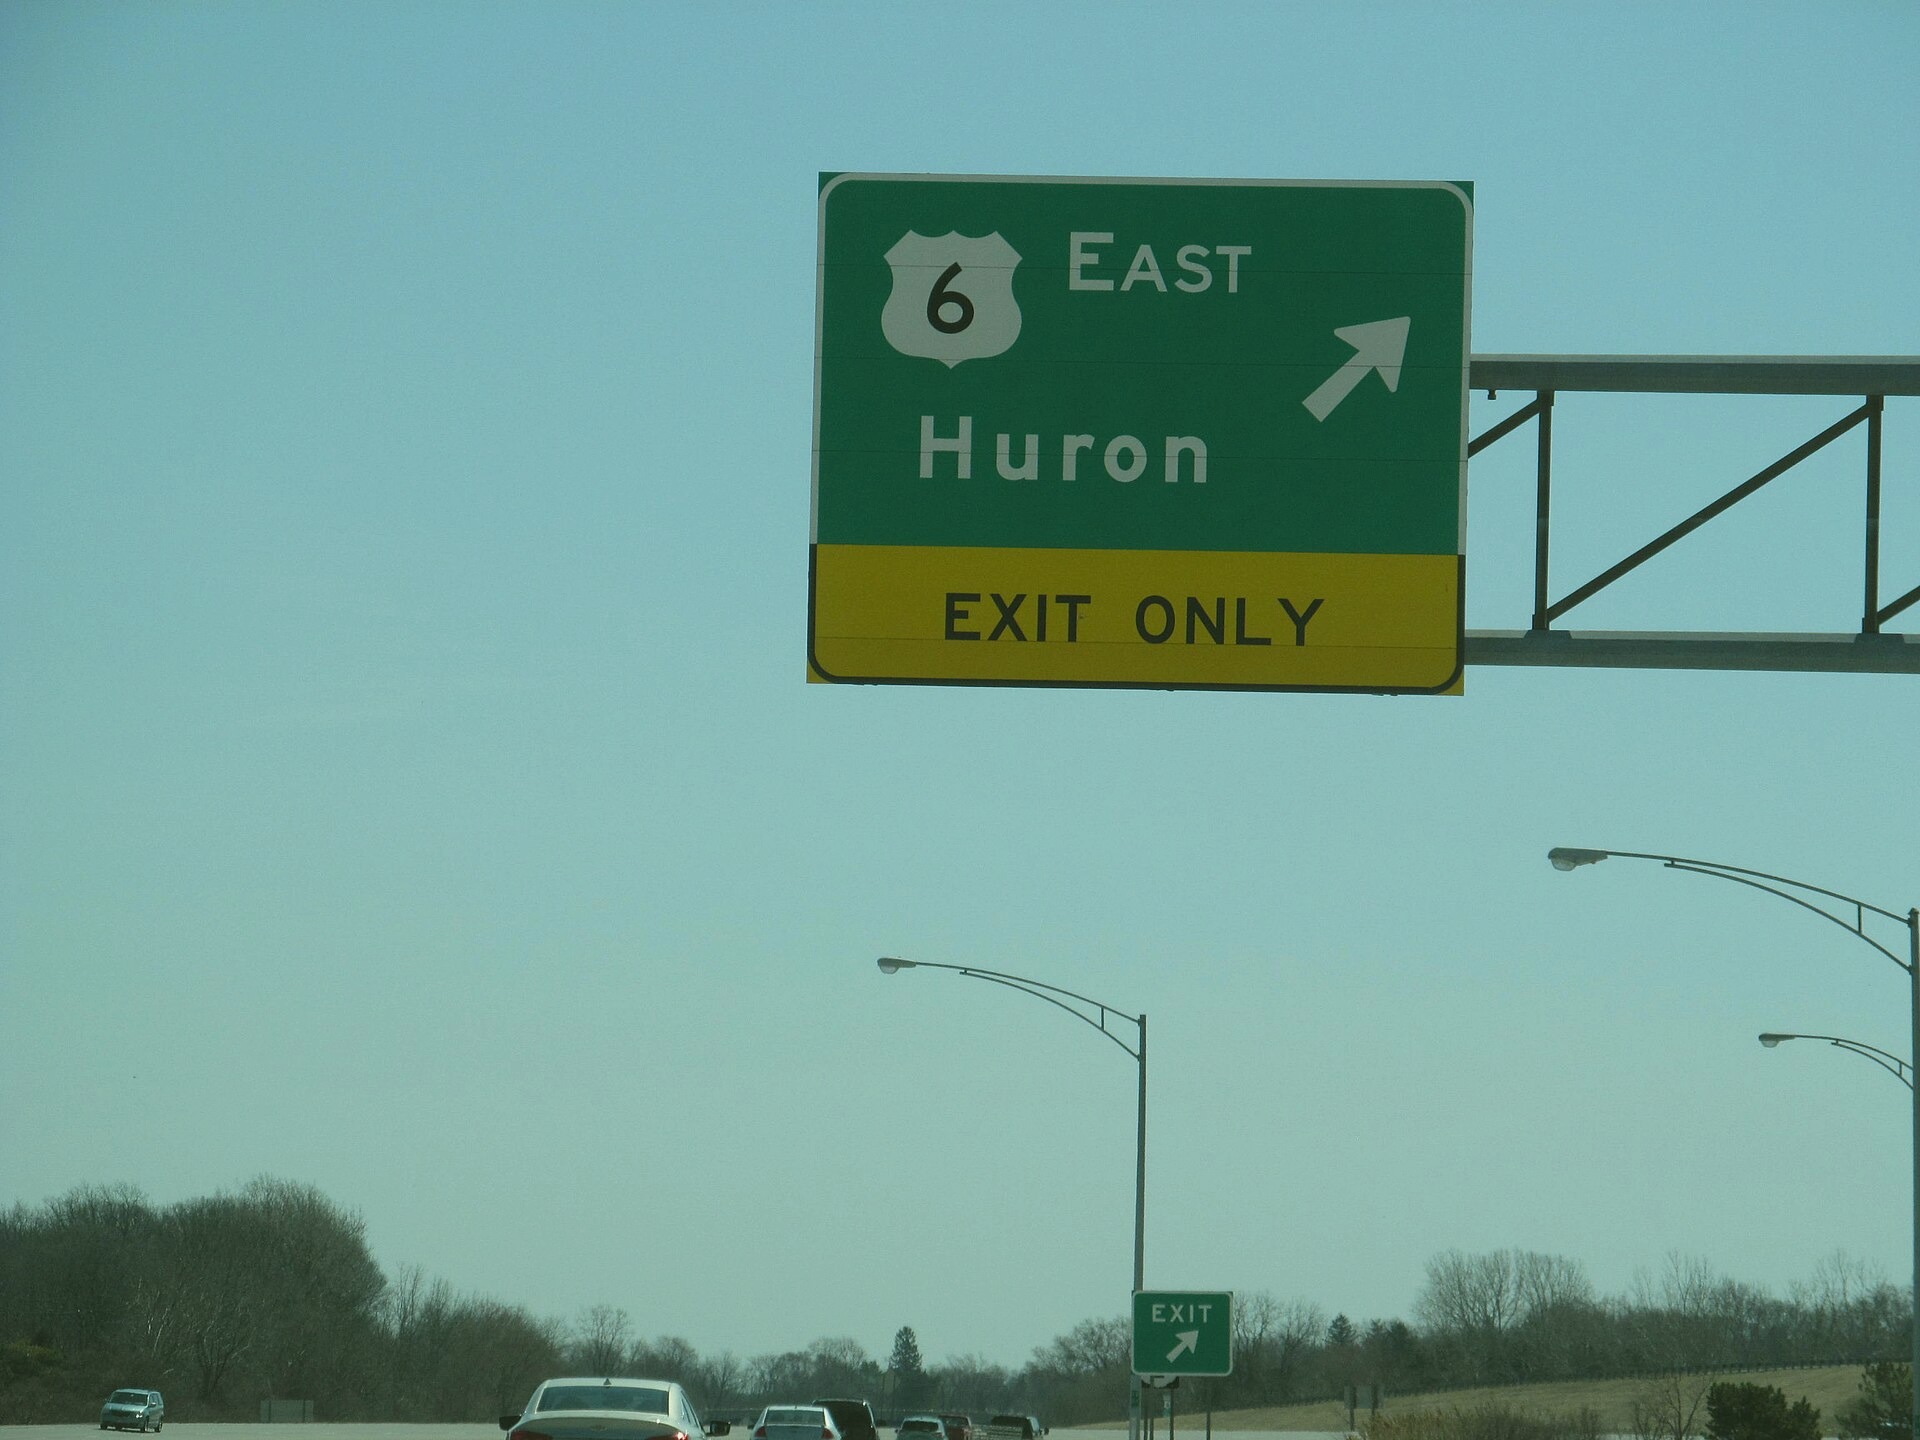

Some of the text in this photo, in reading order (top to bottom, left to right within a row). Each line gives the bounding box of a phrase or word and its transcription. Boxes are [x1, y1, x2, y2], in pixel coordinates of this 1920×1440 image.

[926, 261, 975, 335] 6
[919, 415, 1207, 483] Huron
[944, 592, 1325, 647] EXIT ONLY
[1151, 1304, 1213, 1323] EXIT
